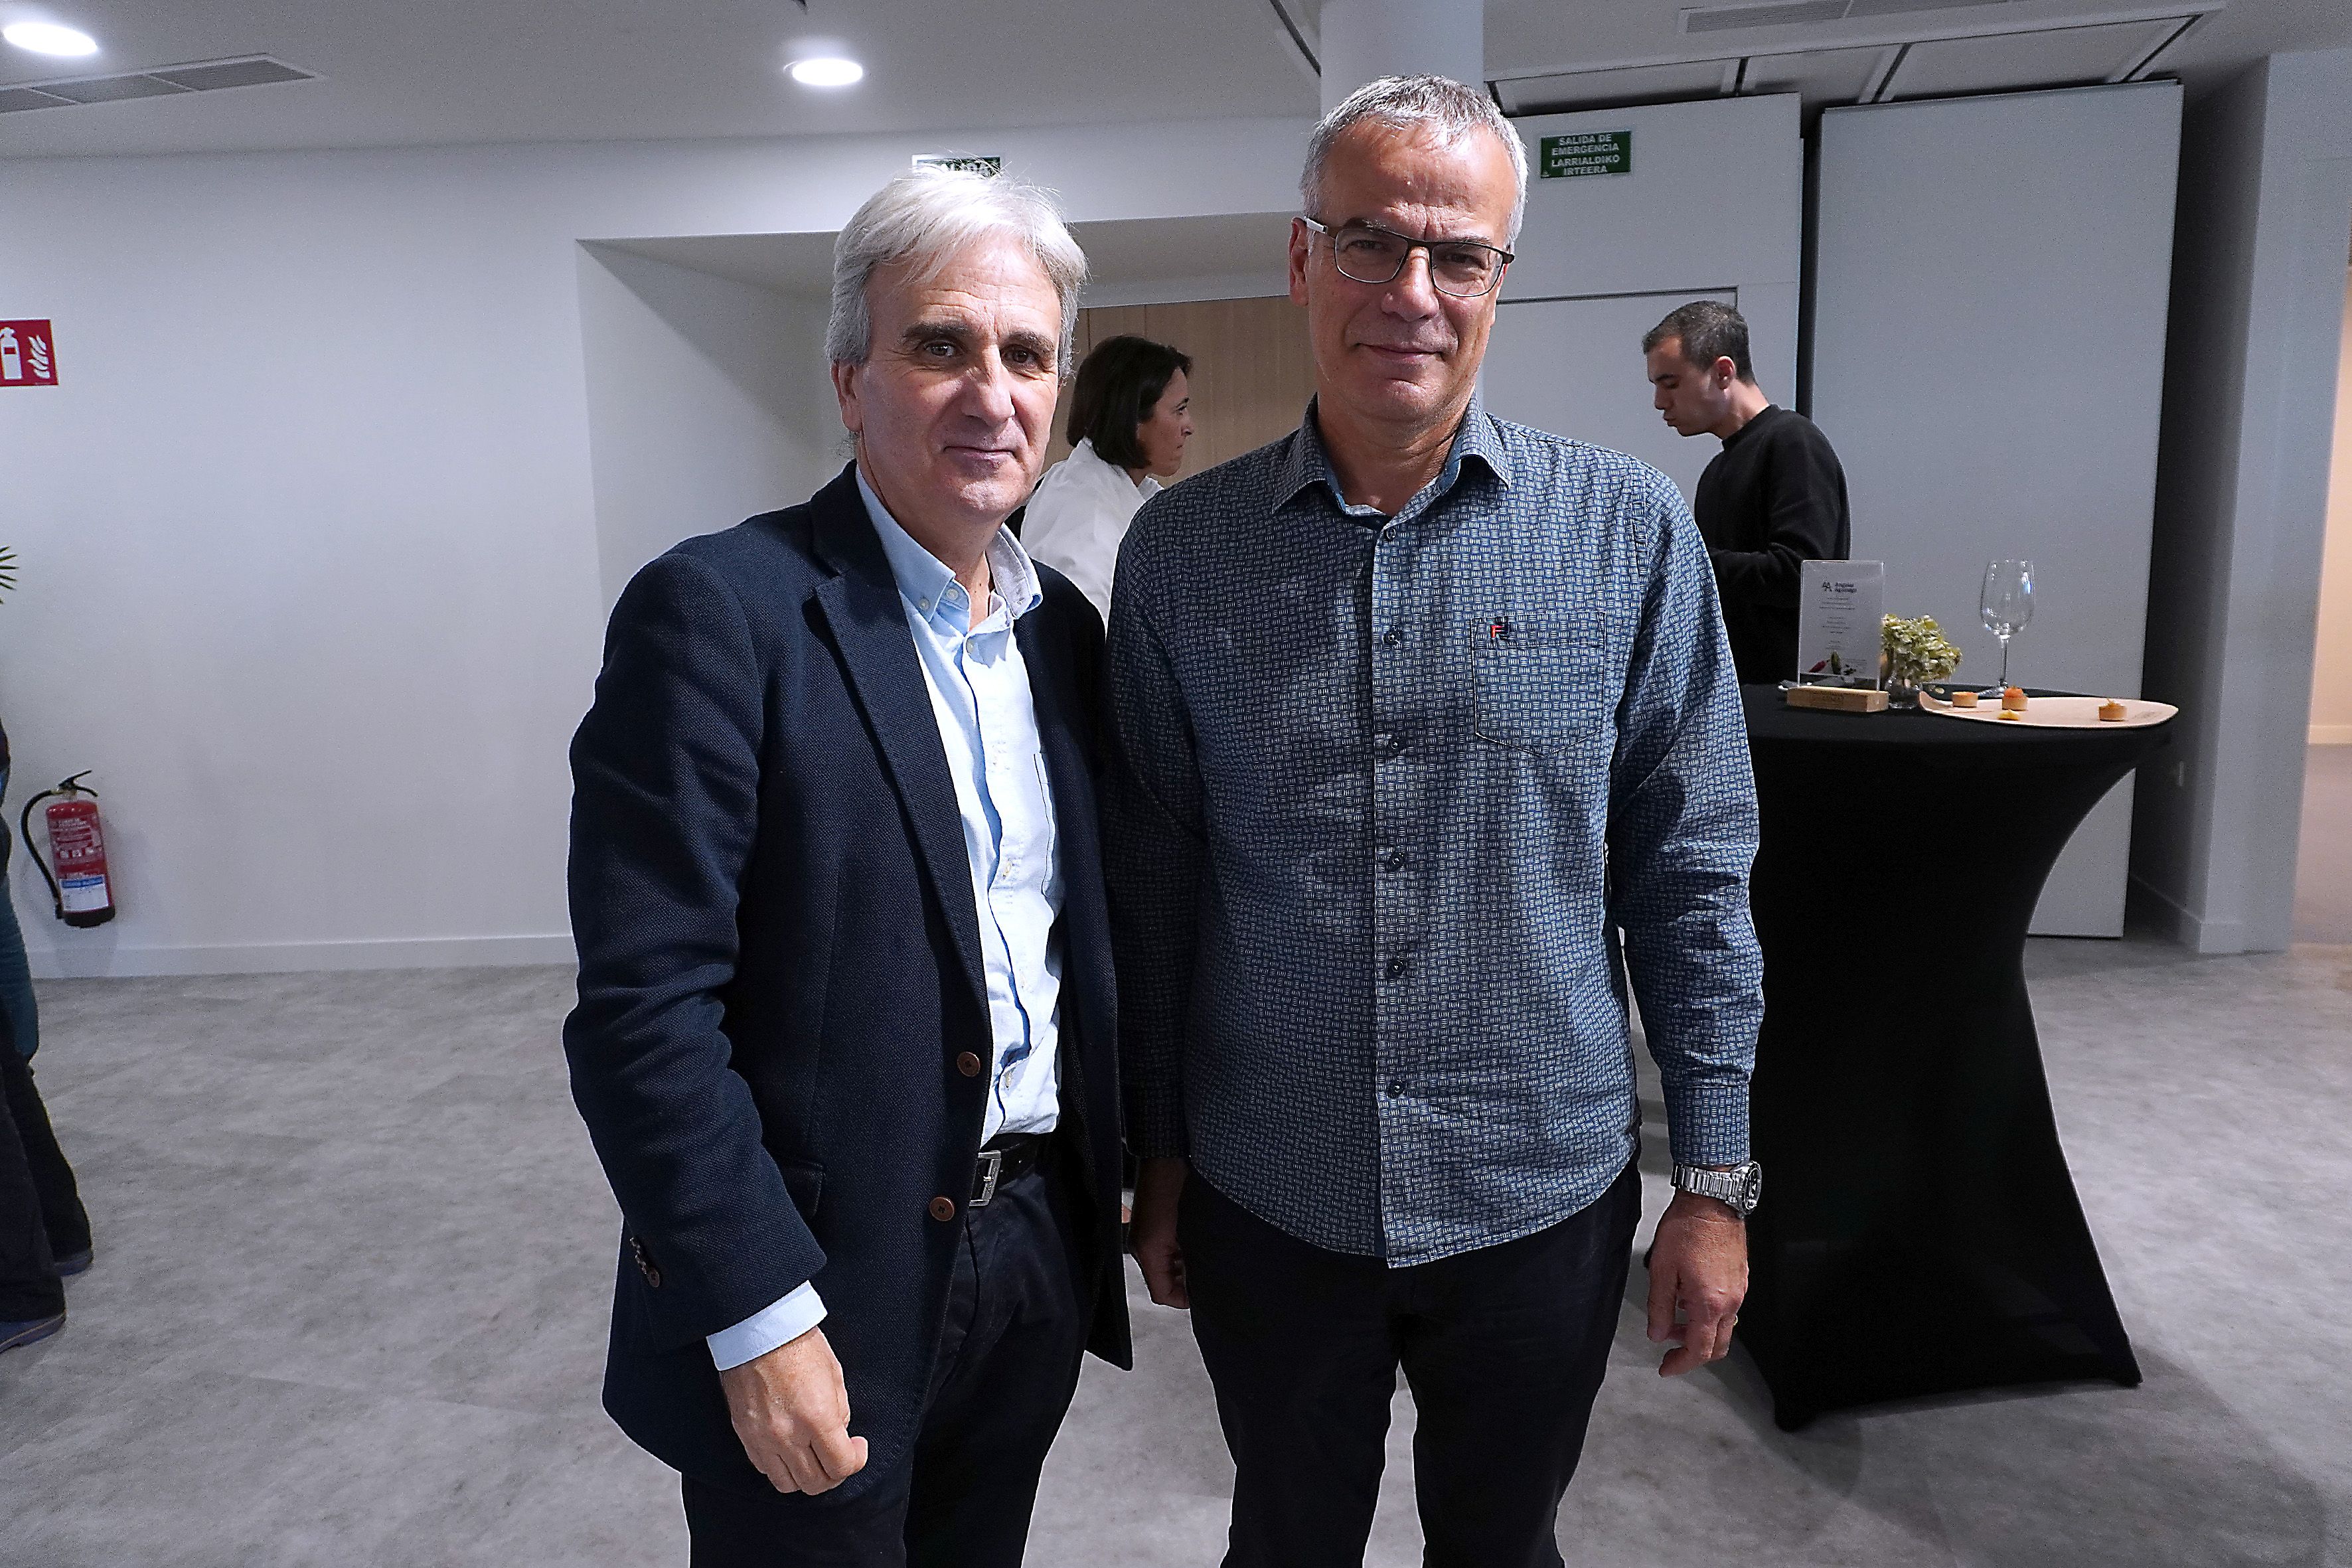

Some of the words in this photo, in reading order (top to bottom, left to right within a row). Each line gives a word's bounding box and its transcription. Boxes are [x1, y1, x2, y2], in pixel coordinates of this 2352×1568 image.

[1559, 135, 1596, 145] SALIDA
[1599, 133, 1612, 142] DE
[1551, 143, 1619, 155] EMERGENCIA
[1551, 154, 1620, 167] LARRIALDIKO
[1564, 165, 1607, 176] IRTEERA
